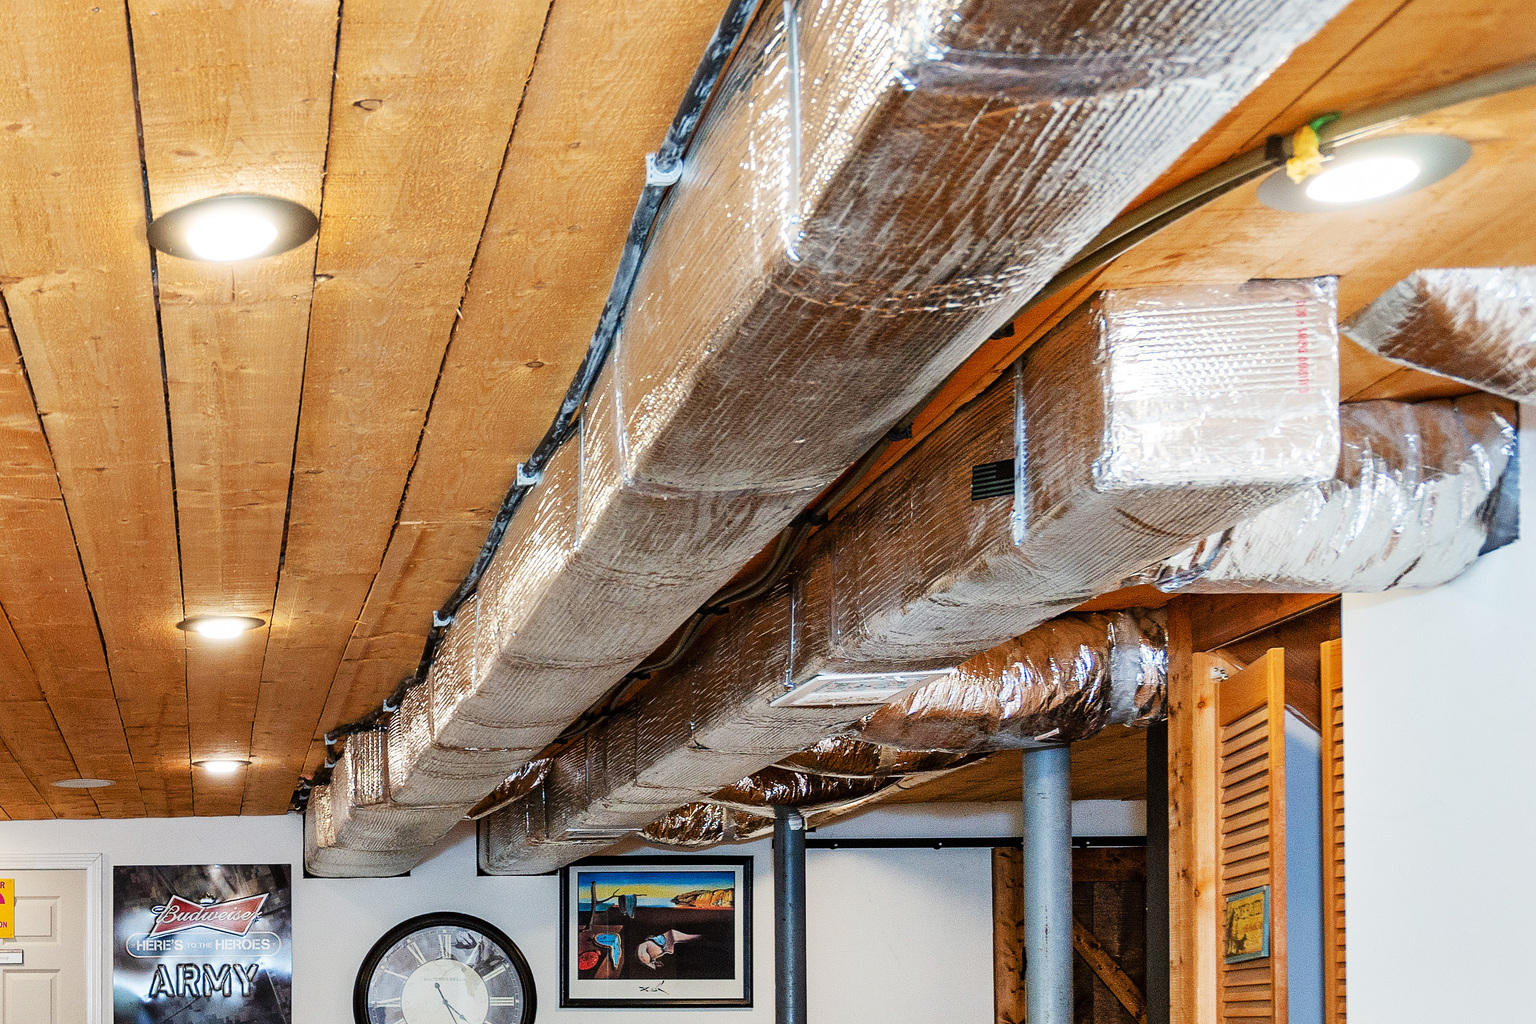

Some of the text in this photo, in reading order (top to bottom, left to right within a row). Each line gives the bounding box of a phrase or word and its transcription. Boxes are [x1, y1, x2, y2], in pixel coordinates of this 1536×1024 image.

[151, 905, 263, 925] Budweiser
[136, 938, 184, 951] HERE'S
[215, 938, 271, 950] HEROES
[149, 963, 260, 998] ARMY
